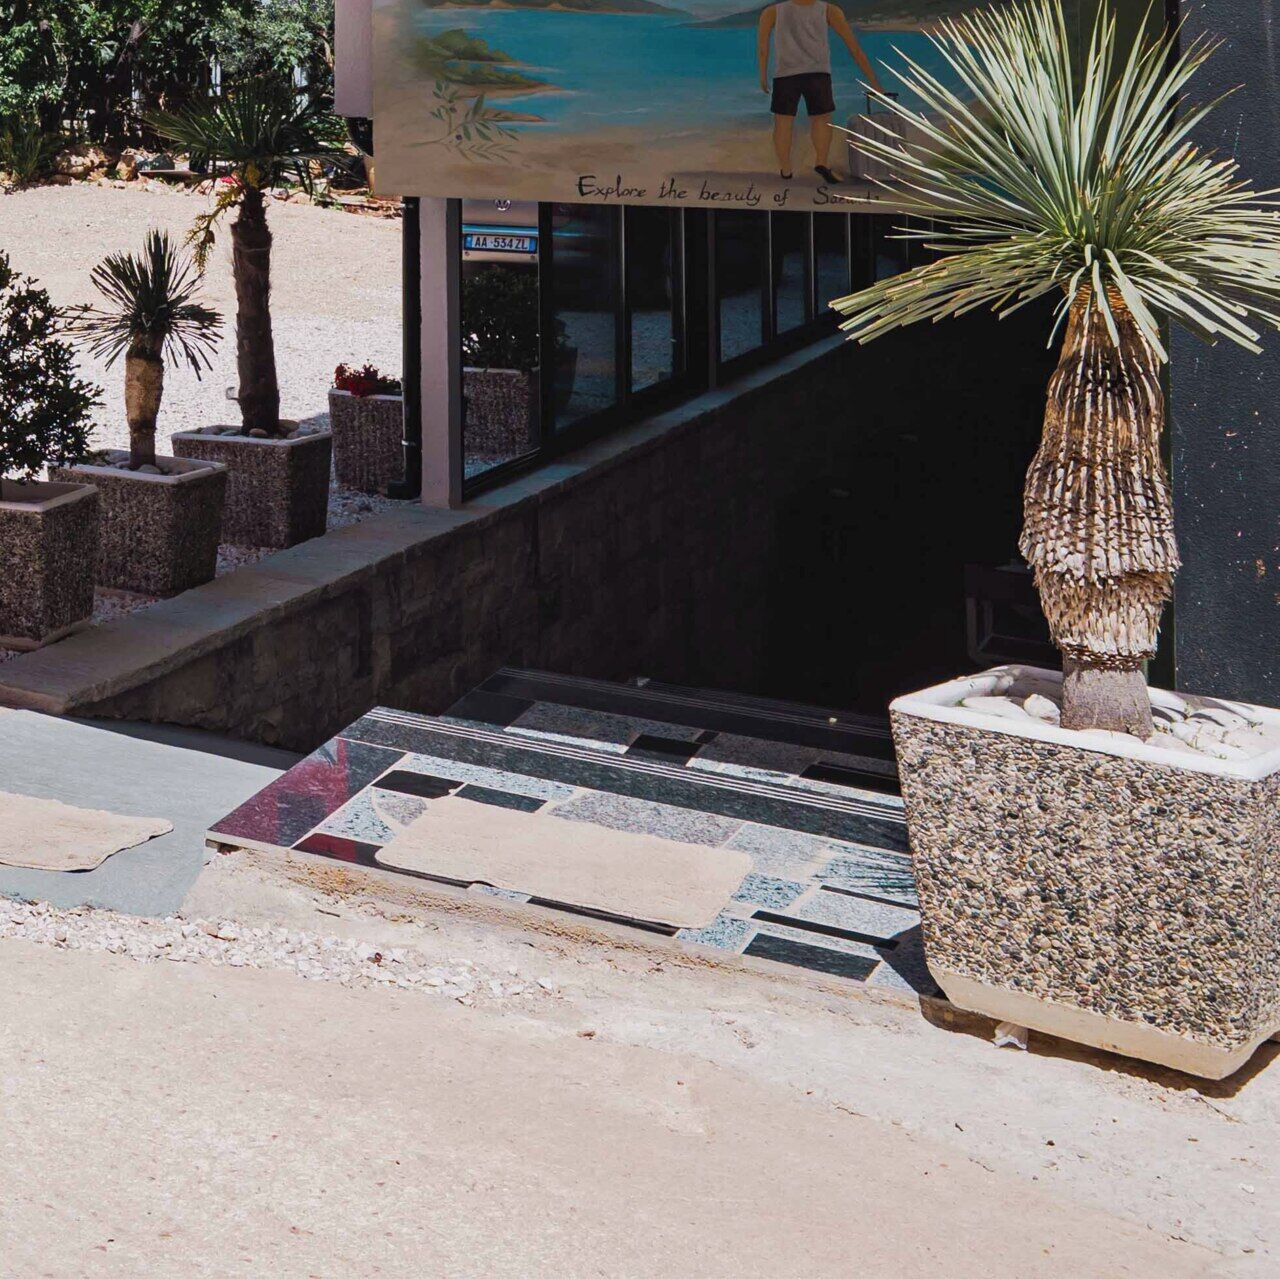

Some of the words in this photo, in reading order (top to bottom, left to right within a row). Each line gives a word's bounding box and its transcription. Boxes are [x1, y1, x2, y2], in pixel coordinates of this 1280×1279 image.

[576, 175, 646, 200] Explore
[658, 178, 687, 199] the
[699, 180, 762, 206] beauty
[773, 190, 789, 206] of
